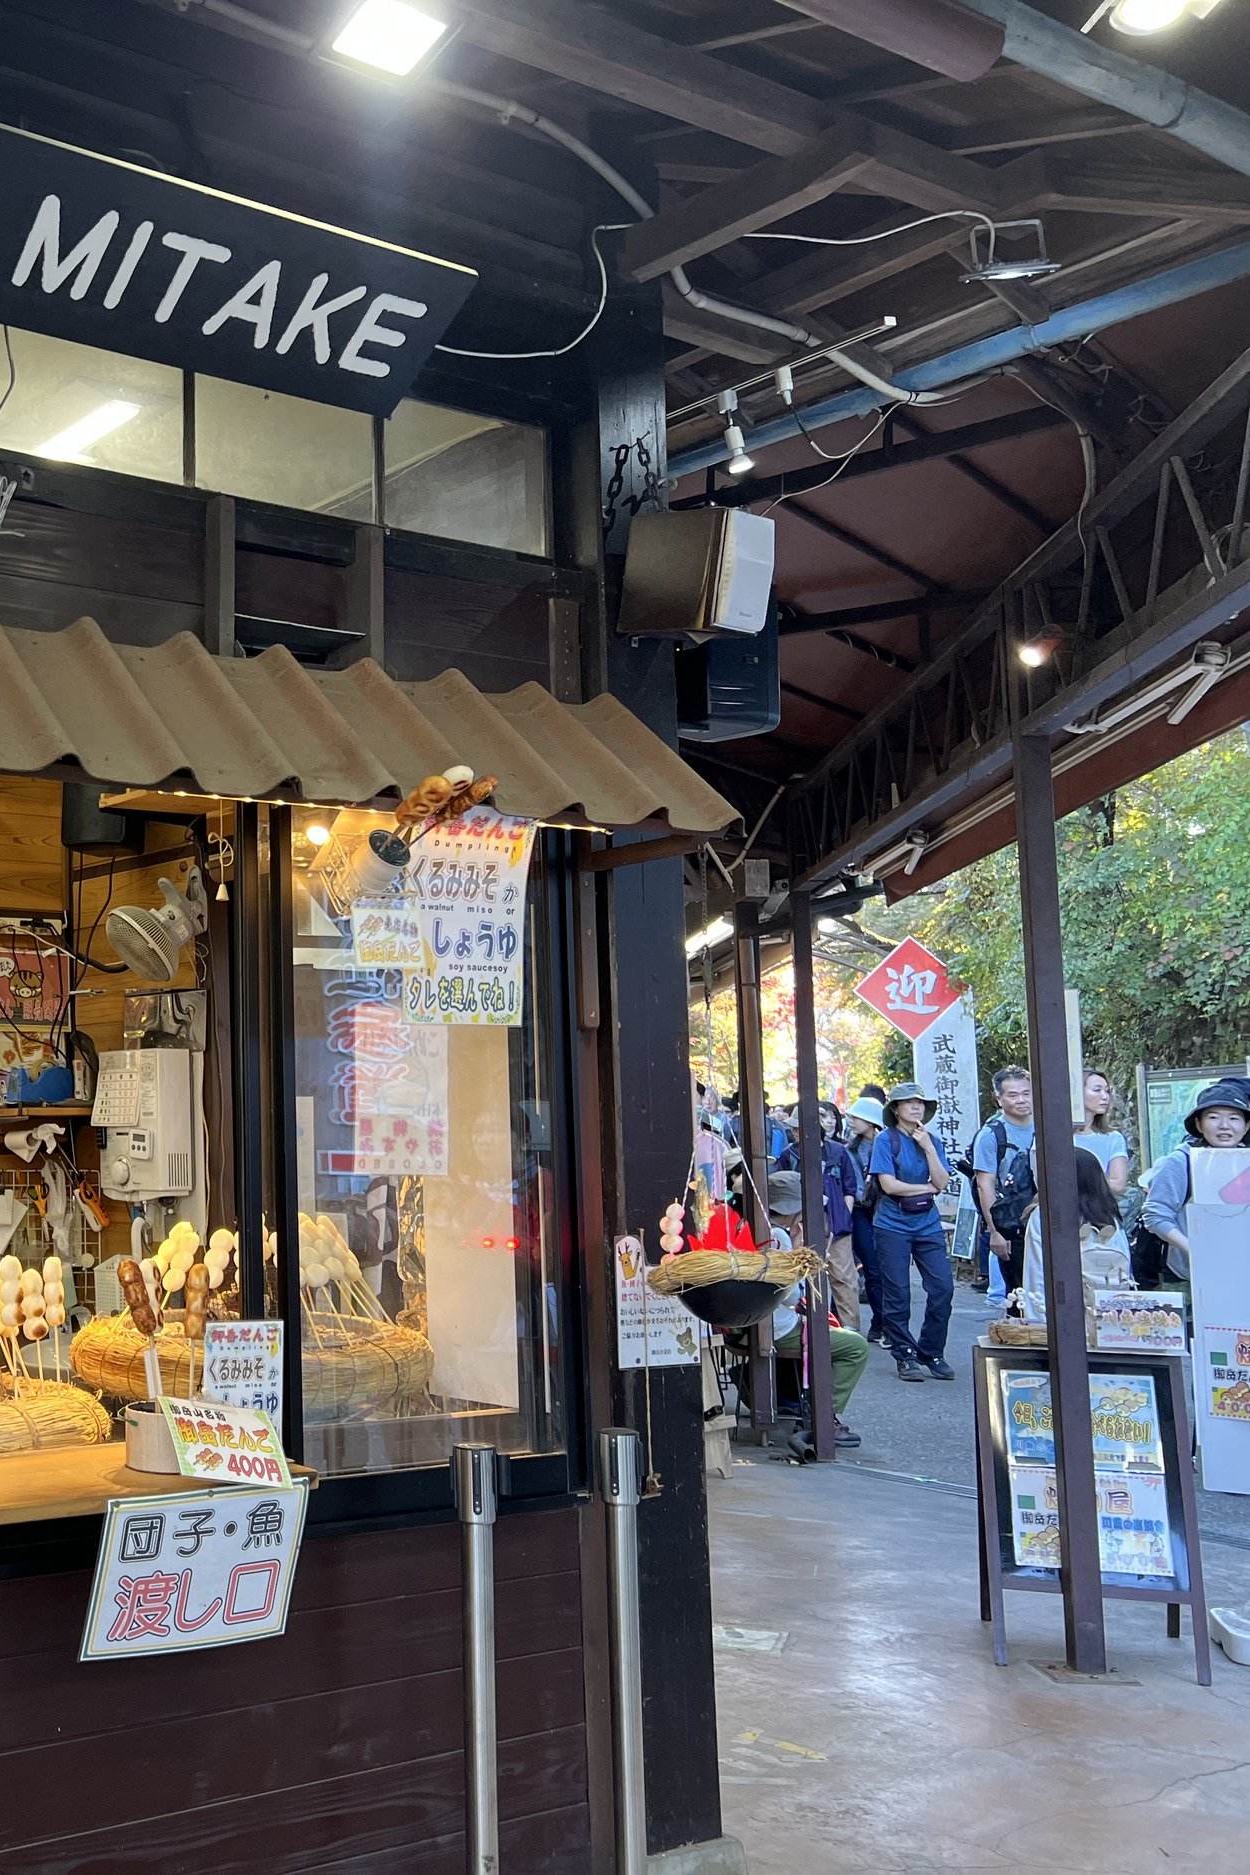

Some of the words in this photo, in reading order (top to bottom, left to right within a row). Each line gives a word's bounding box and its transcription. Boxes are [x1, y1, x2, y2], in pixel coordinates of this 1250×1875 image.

[10, 193, 428, 379] MITAKE
[411, 856, 500, 903] くるみみそ
[427, 903, 454, 911] walnut
[506, 907, 515, 915] or
[432, 918, 518, 962] しょうゆ
[449, 963, 464, 973] soy
[884, 964, 940, 1015] 迎
[208, 1356, 266, 1383] くるみみそ
[174, 1416, 274, 1453] 御岳だんご
[228, 1454, 283, 1482] 400円
[118, 1500, 285, 1564] 団子・魚
[107, 1559, 282, 1642] 渡し口
